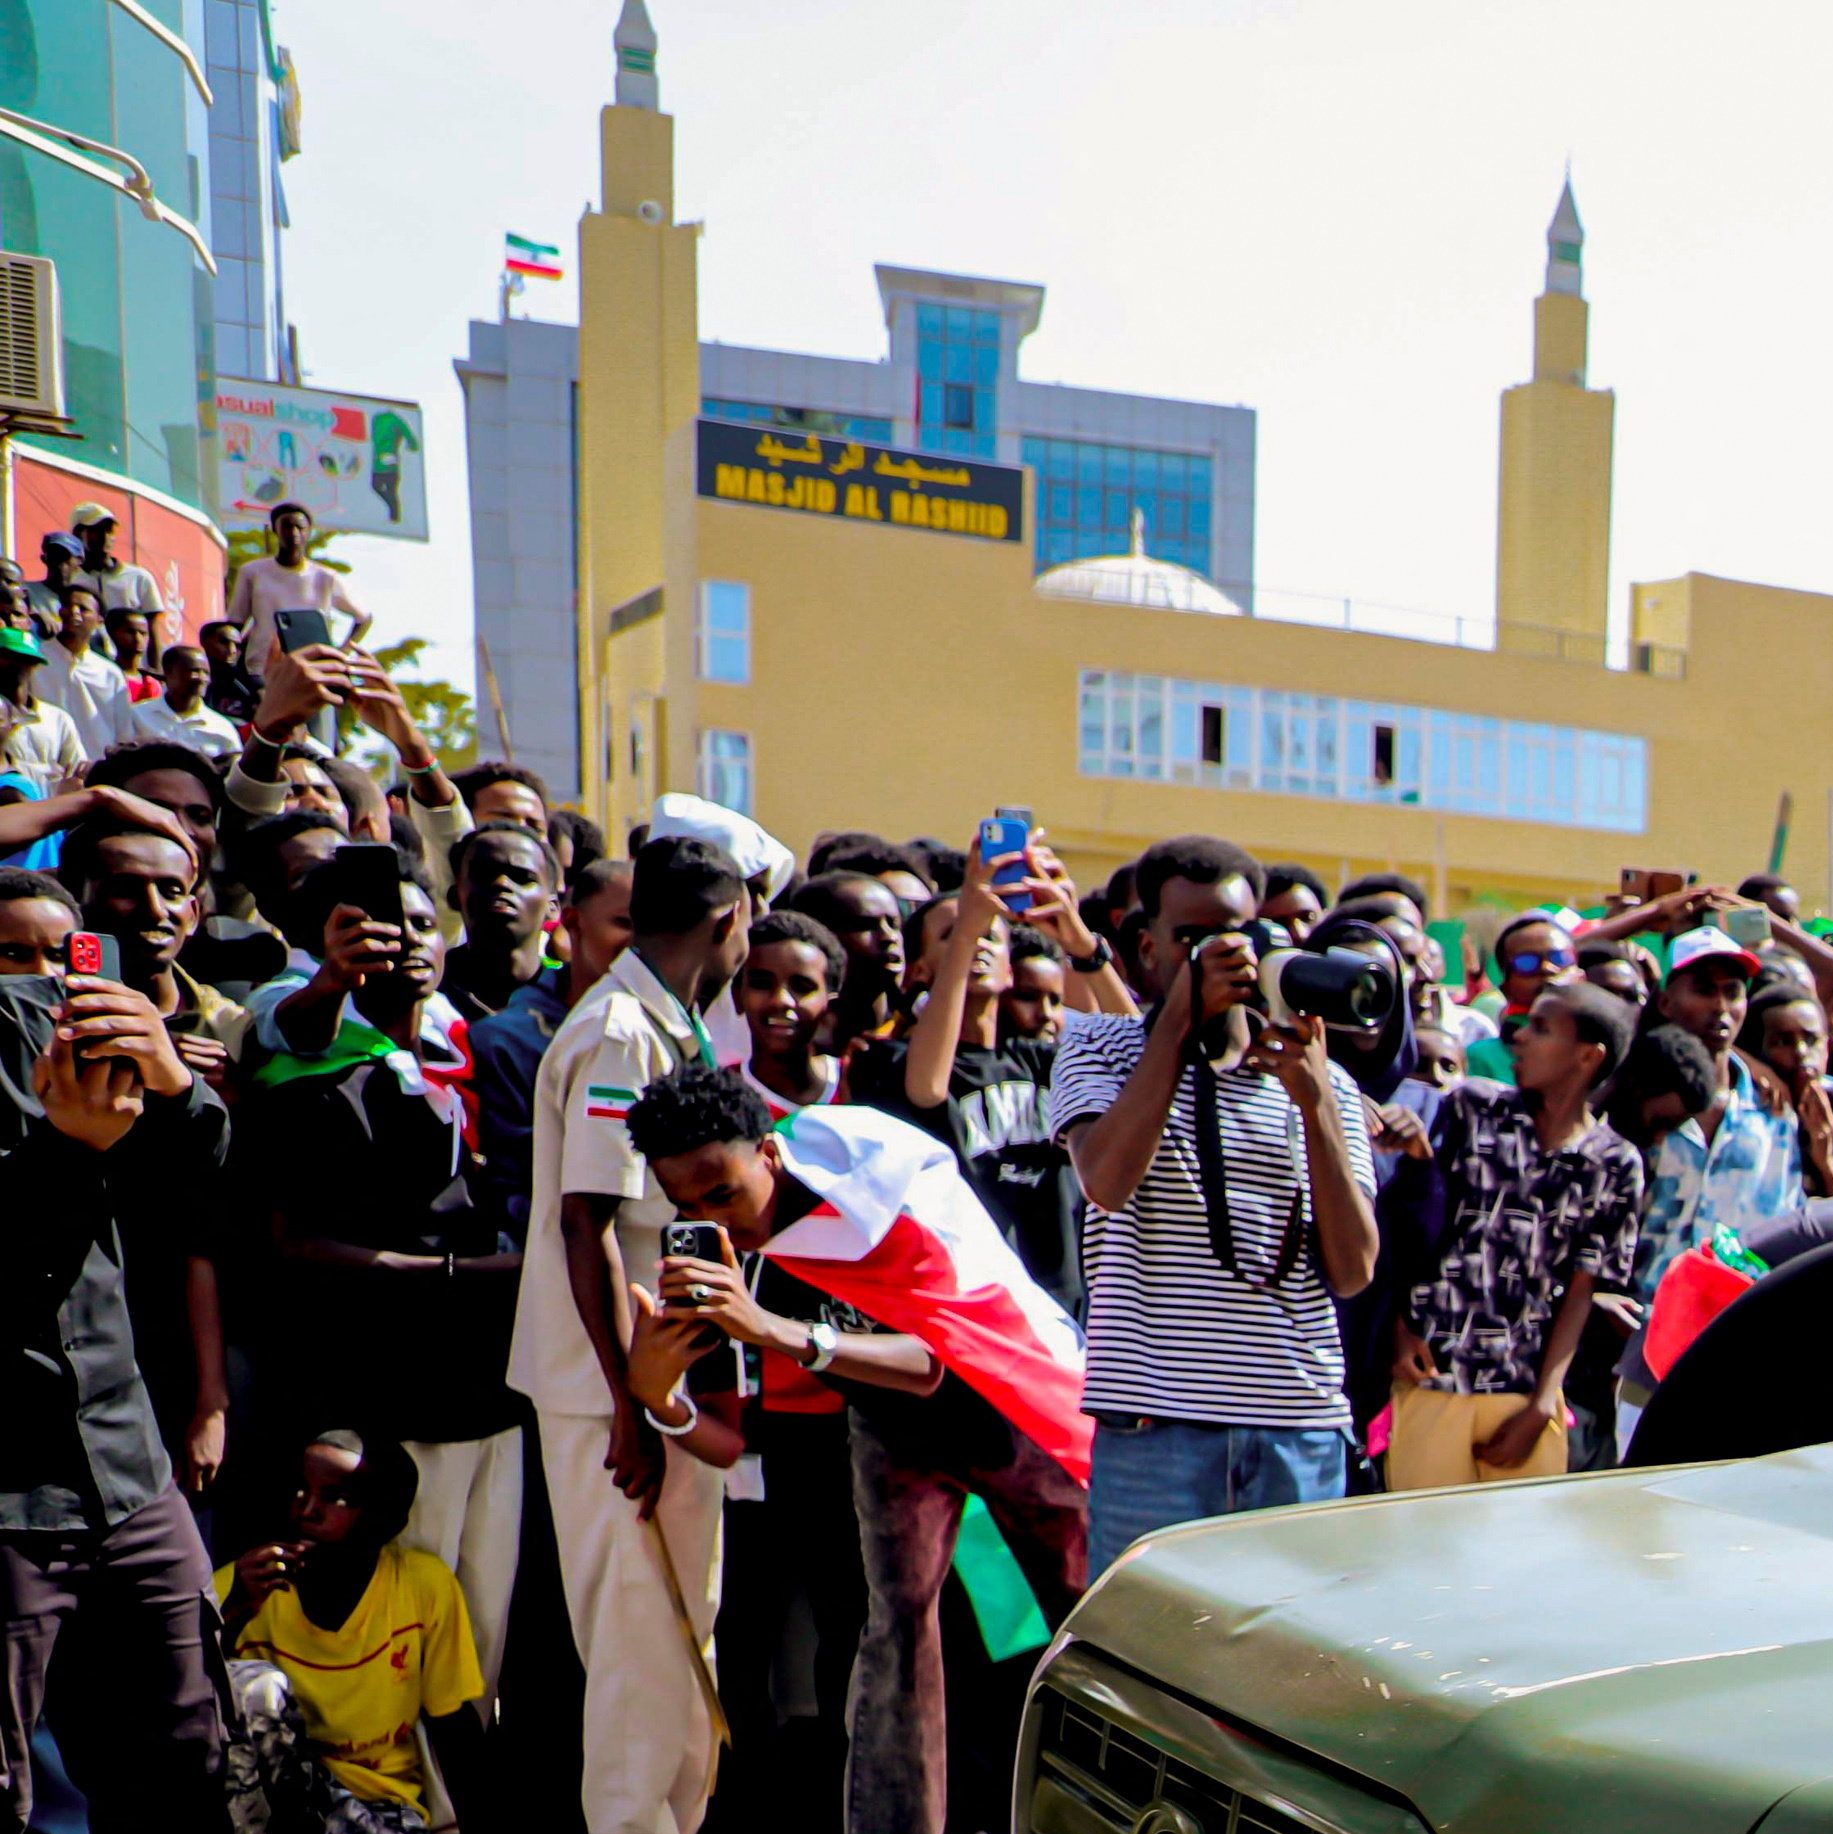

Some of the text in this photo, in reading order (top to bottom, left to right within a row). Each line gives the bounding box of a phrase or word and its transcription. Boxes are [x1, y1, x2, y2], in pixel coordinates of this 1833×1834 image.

[715, 462, 1008, 540] MASJID AL RASHIID
